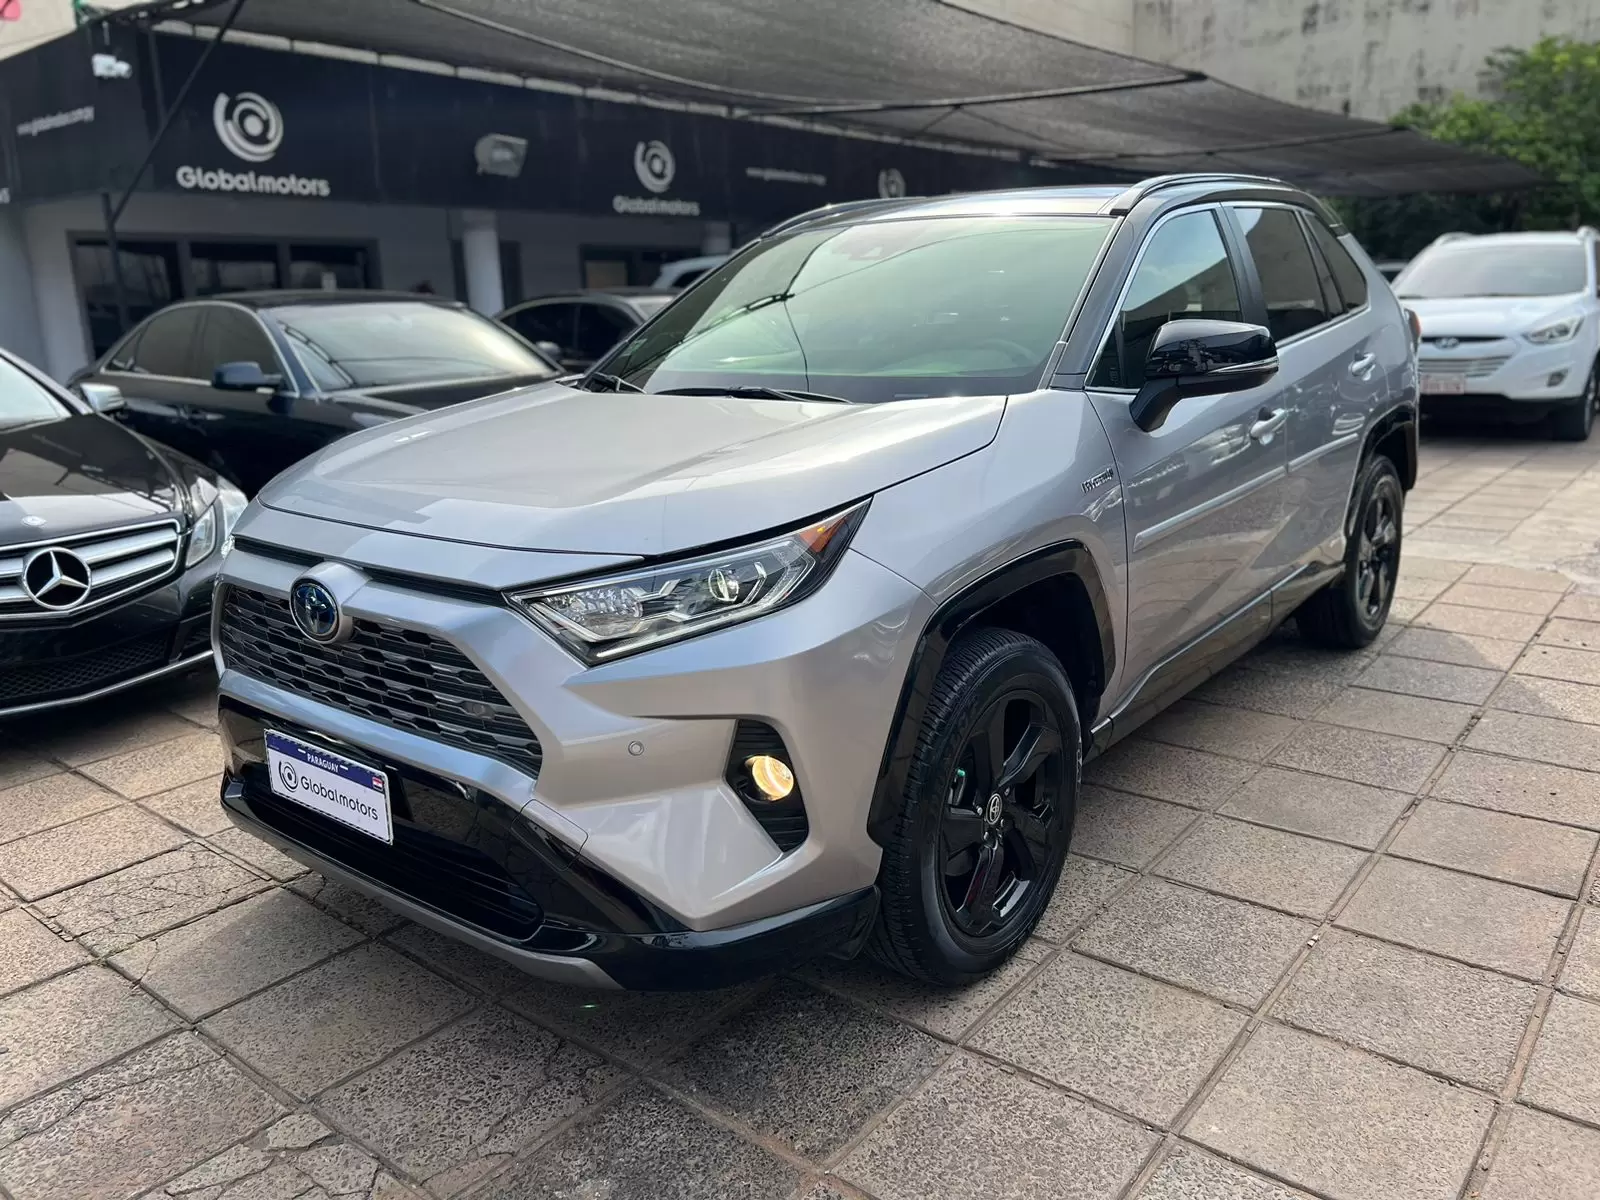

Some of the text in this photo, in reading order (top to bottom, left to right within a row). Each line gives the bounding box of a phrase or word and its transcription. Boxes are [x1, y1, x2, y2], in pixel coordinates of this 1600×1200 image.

[176, 165, 330, 197] Globalmotors
[306, 753, 340, 773] PARAGUAY
[300, 776, 379, 821] Globalmotors
